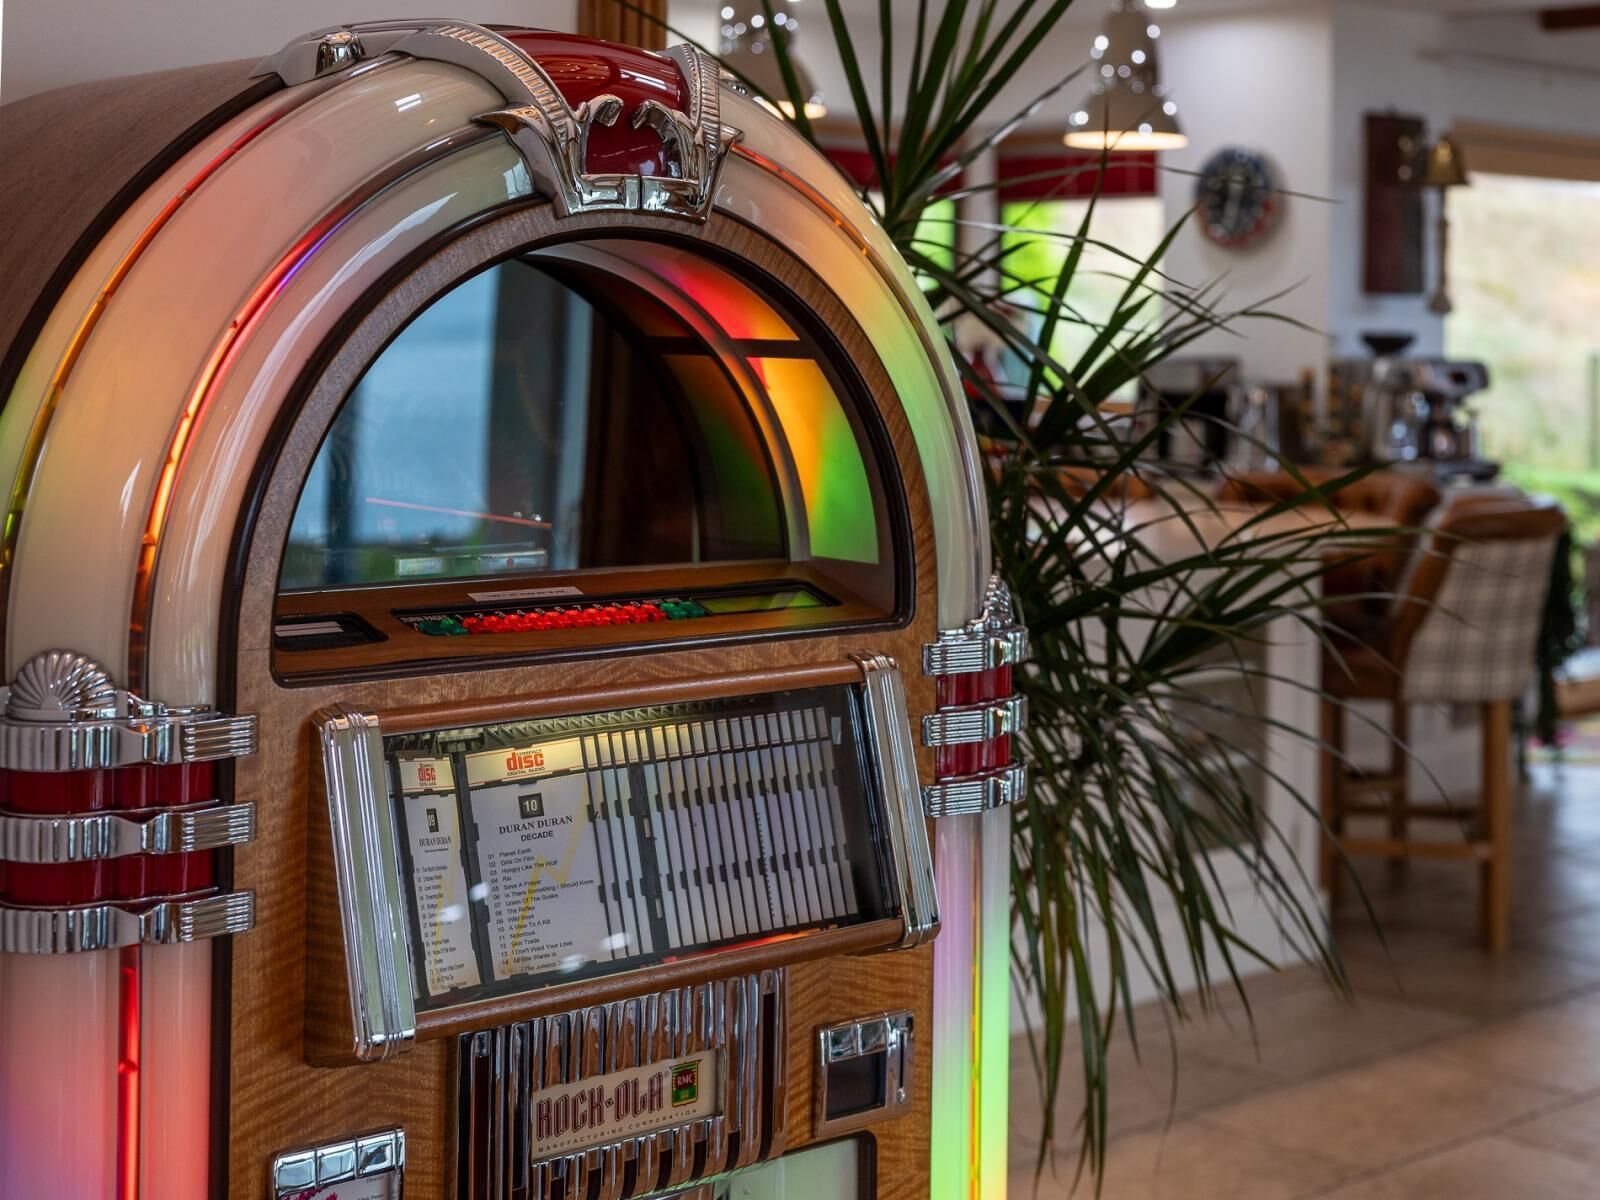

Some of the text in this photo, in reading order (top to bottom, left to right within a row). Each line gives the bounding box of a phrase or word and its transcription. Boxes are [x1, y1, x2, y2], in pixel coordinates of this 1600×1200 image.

[506, 752, 545, 771] disc
[523, 800, 538, 812] 10
[499, 815, 574, 835] DURAN DURAN
[520, 830, 555, 842] DECADE
[499, 851, 516, 859] Planet
[501, 865, 520, 875] Hungry
[528, 885, 556, 896] Something
[560, 881, 578, 889] Should
[524, 938, 540, 946] Trade
[559, 940, 573, 948] Love
[677, 1073, 693, 1087] RMC
[538, 1108, 697, 1153] MANUFACTURING CORPORATION
